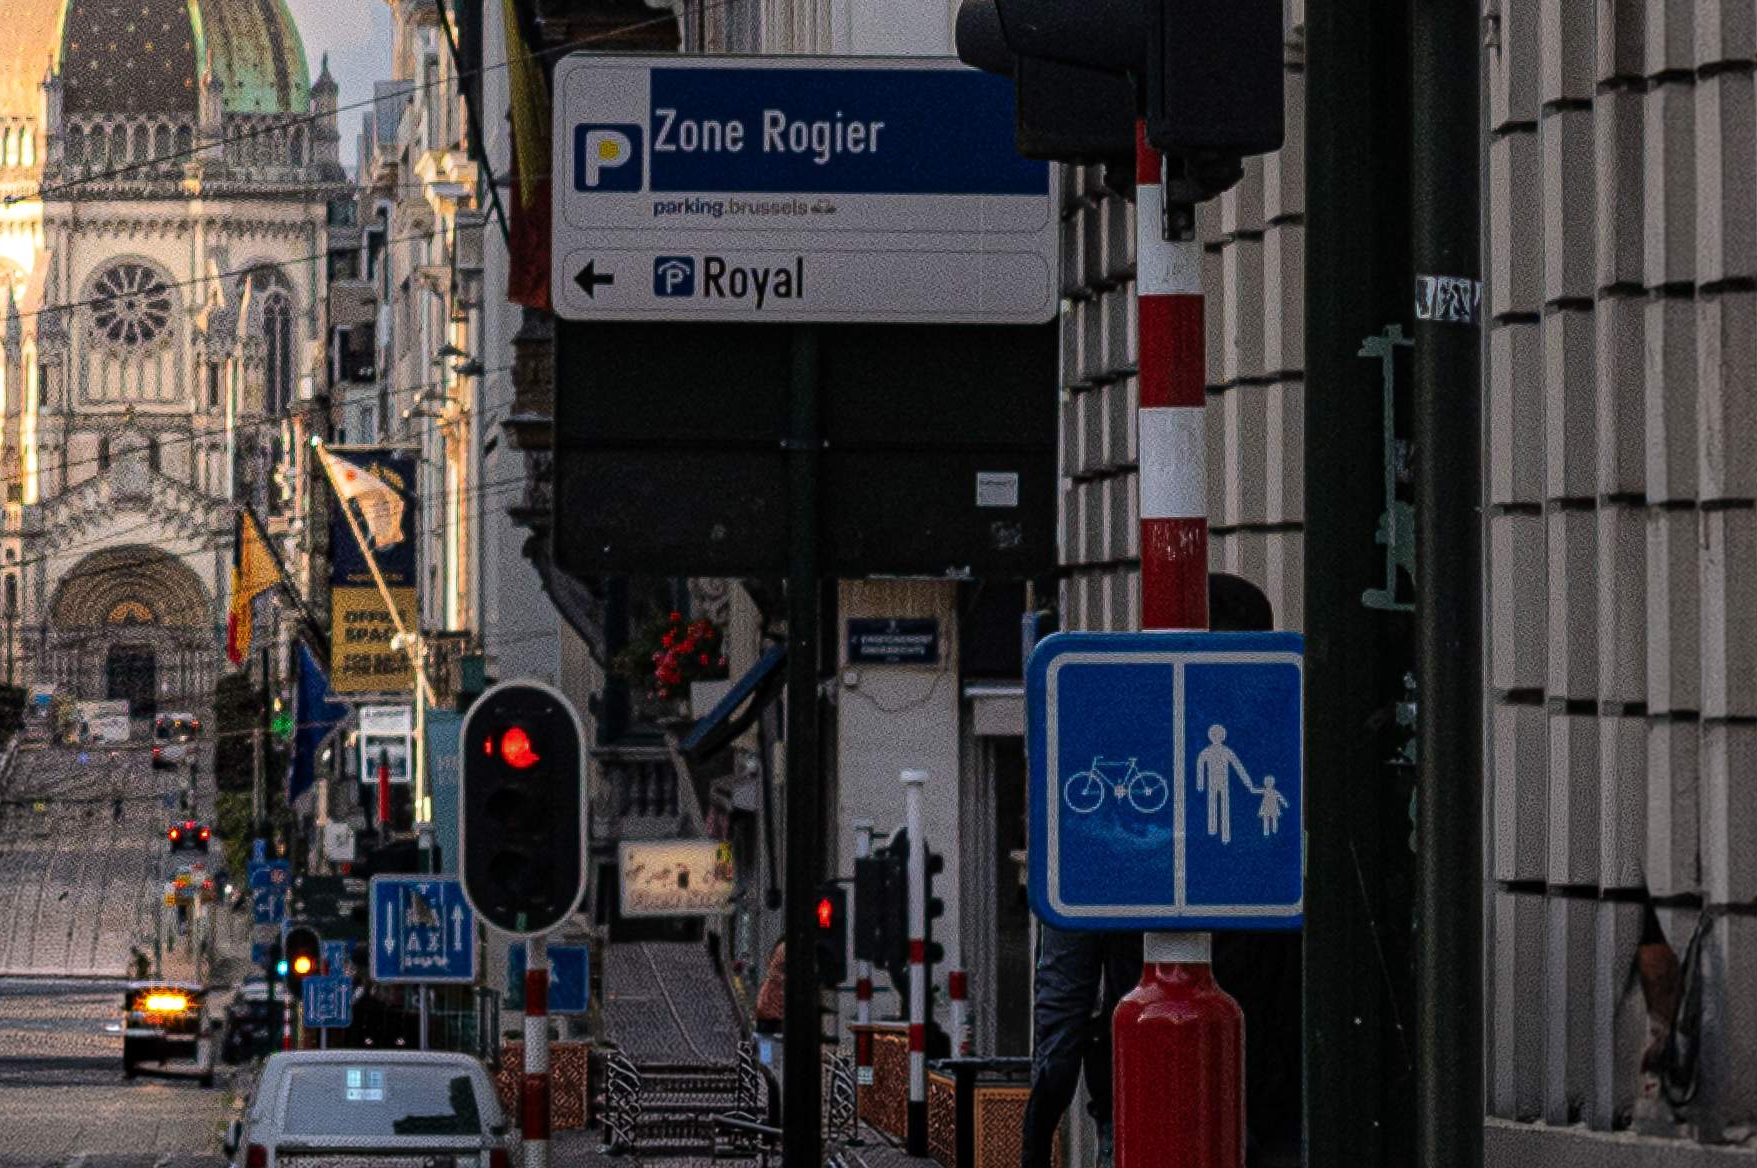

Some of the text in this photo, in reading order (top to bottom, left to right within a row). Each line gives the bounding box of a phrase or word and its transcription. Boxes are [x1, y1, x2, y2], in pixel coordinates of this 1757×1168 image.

[585, 130, 632, 187] P
[653, 107, 886, 165] Zone Rogier
[653, 197, 809, 218] parking.brussels
[703, 256, 805, 310] Royal
